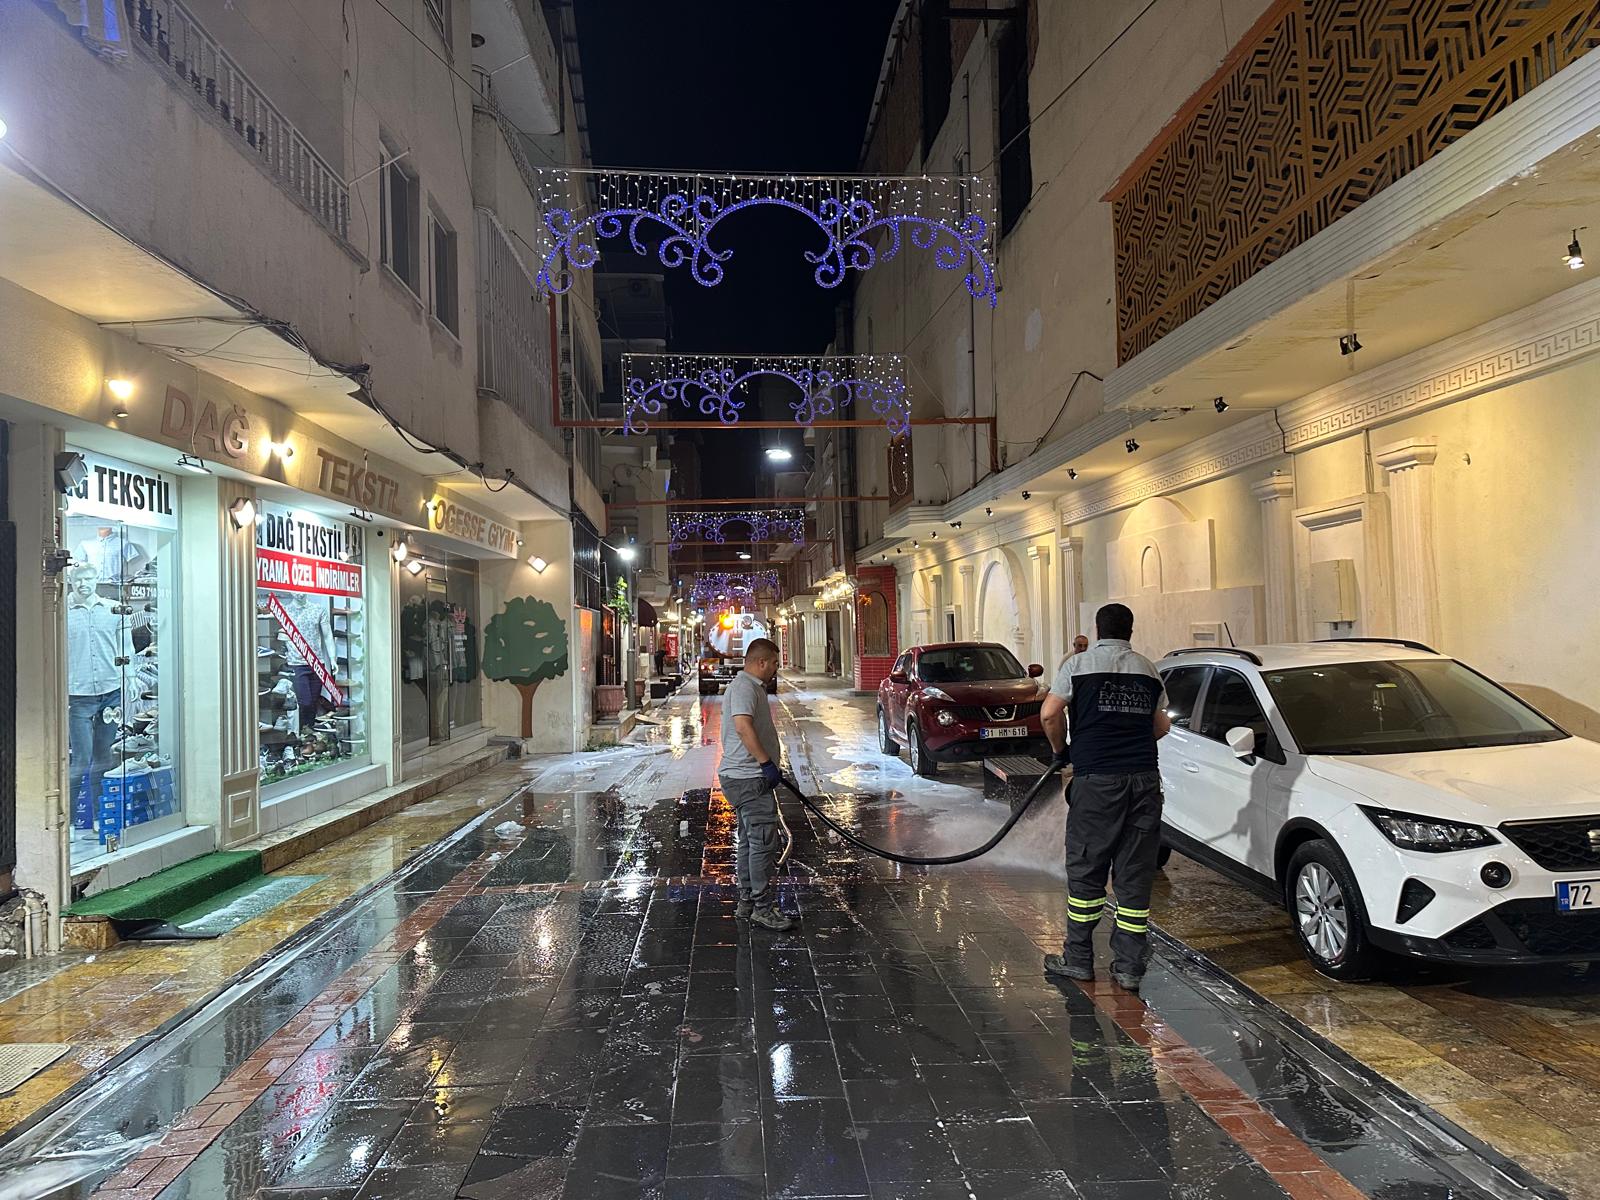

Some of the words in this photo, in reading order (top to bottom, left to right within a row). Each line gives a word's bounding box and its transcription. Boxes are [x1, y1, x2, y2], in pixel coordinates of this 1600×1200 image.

[160, 384, 249, 459] DAĞ
[94, 465, 172, 515] TEKSTİL
[266, 511, 294, 551] DAĞ
[297, 521, 342, 561] TEKSTİL
[291, 558, 315, 587] ÖZEL
[316, 562, 360, 592] İNDİRİMLER
[270, 597, 294, 637] BABALAR
[1099, 690, 1151, 702] BATMAN
[1012, 728, 1026, 736] 616
[1570, 885, 1592, 906] 72
